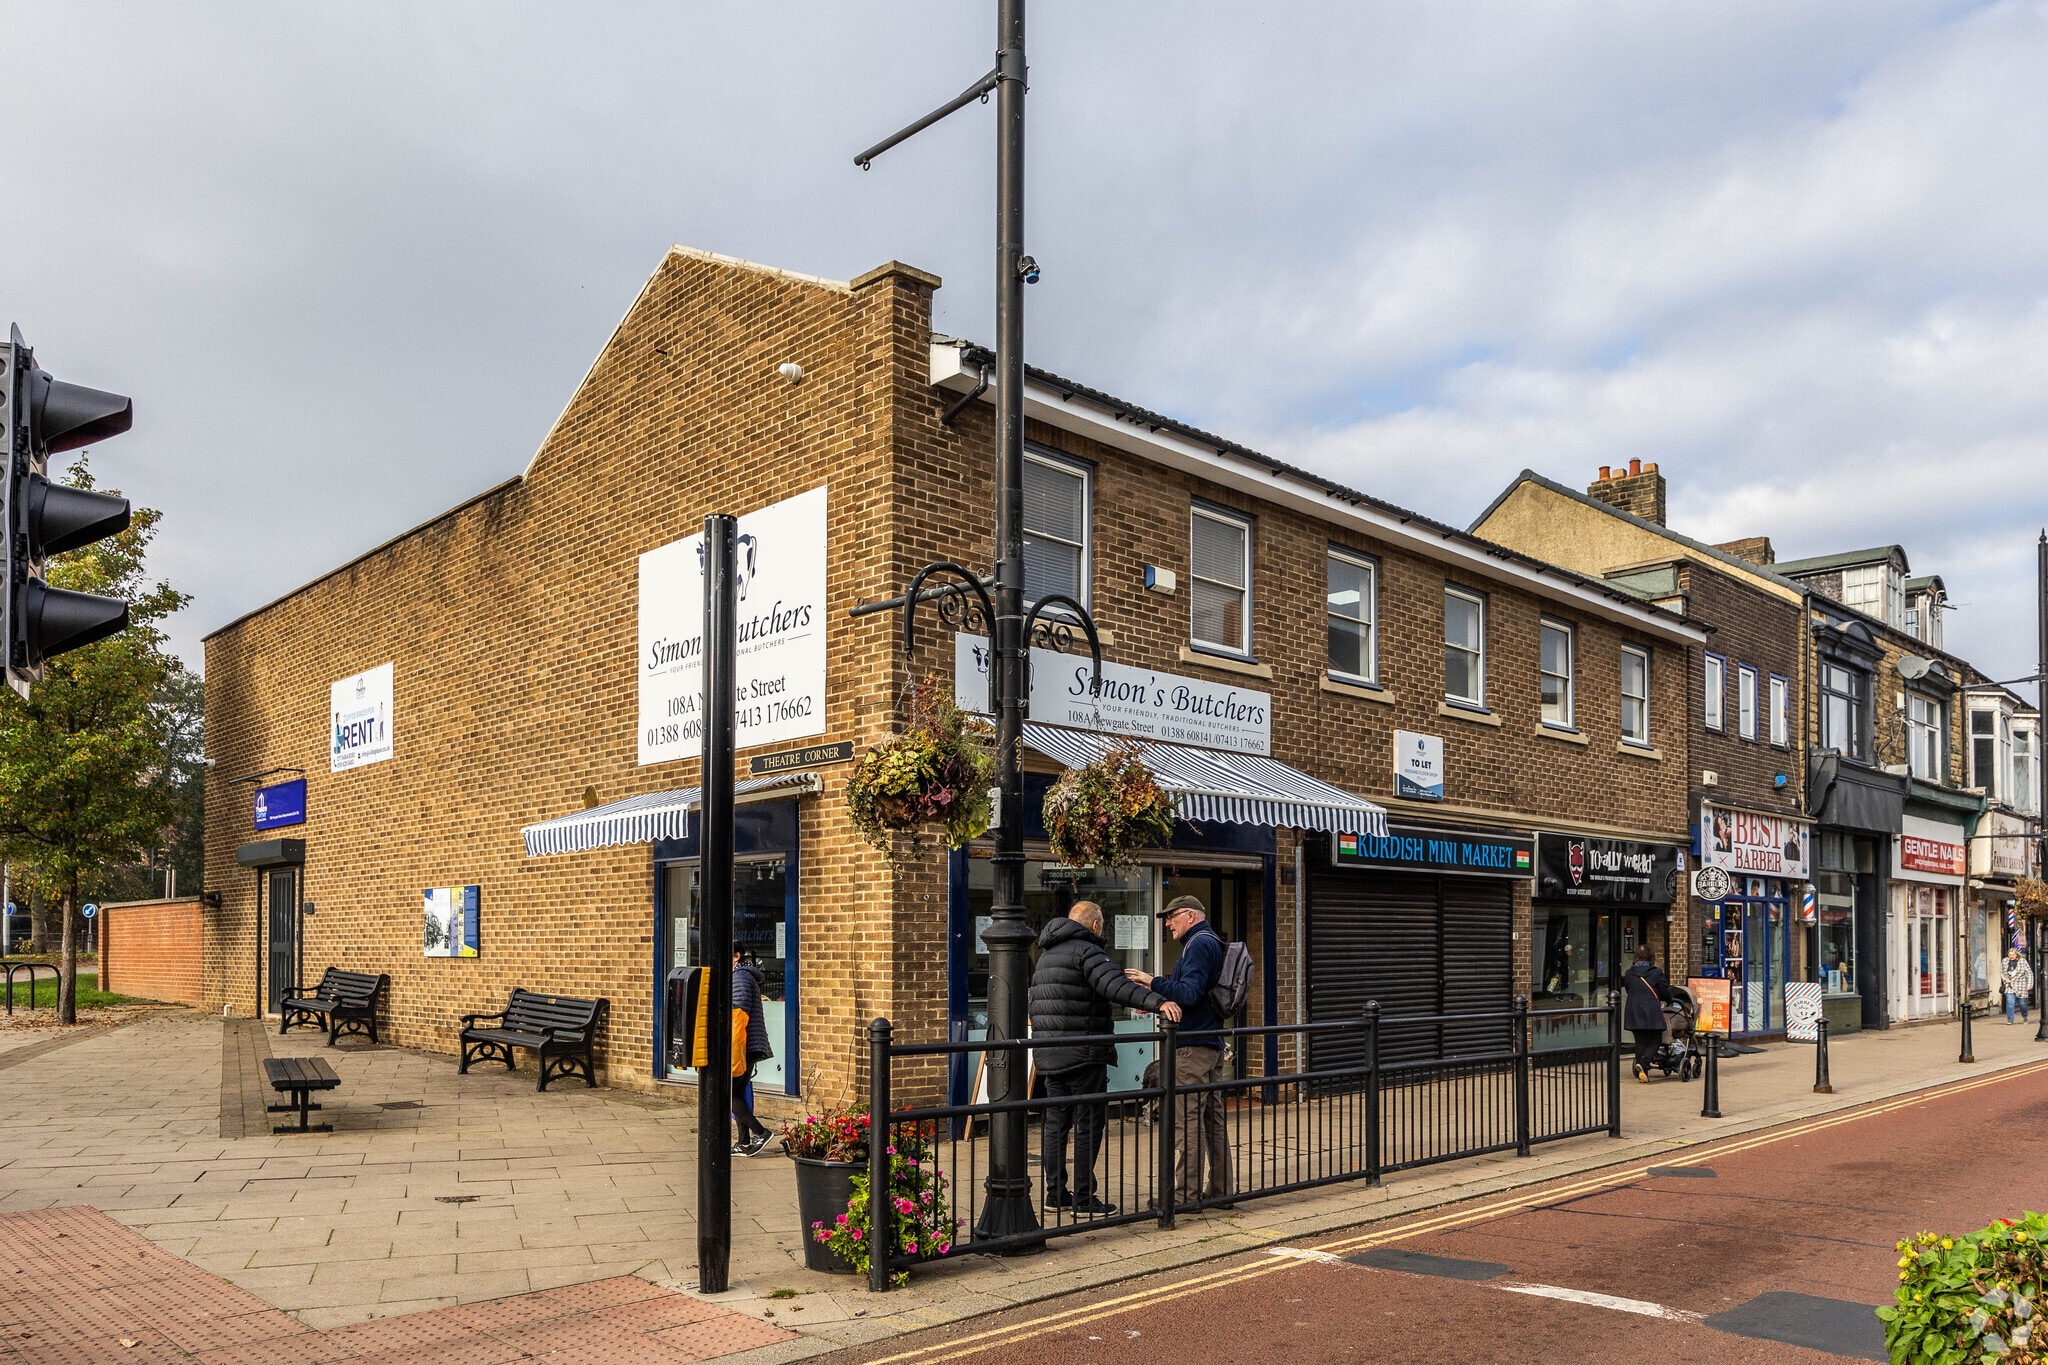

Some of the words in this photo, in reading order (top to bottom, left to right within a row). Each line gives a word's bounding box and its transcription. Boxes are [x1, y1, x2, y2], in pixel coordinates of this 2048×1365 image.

[648, 636, 701, 670] Simon
[738, 600, 812, 643] utchers
[669, 664, 684, 674] YOUR
[685, 659, 703, 670] FRIEN
[753, 637, 786, 652] BUTCHERS
[667, 695, 695, 717] 108A
[750, 675, 786, 699] Street
[1171, 685, 1265, 725] Butchers
[343, 717, 375, 750] RENT
[647, 723, 679, 747] 01388
[683, 719, 702, 740] 608
[735, 706, 762, 729] 7413
[766, 695, 812, 724] 176662
[1068, 710, 1090, 724] 108A
[1131, 719, 1154, 733] Street
[1161, 726, 1185, 740] 01388
[1240, 737, 1265, 751] 176662
[1102, 703, 1122, 713] YOUR
[1124, 707, 1159, 720] FRIENDLY,
[1161, 713, 1206, 727] TRADITIONAL
[1208, 721, 1240, 732] BUTCHERS
[763, 752, 800, 769] THEATRE
[804, 746, 839, 762] CORNER
[1411, 759, 1420, 768] TO
[1421, 760, 1432, 769] LET
[1734, 811, 1782, 850] BEST
[1358, 834, 1424, 862] KURDISH
[1428, 839, 1458, 865] MINI
[1462, 843, 1513, 868] MARKET
[1734, 847, 1782, 873] BARBER
[1905, 838, 1938, 858] GENTLE
[1940, 845, 1964, 863] NAILS
[1698, 881, 1727, 889] BARBERS
